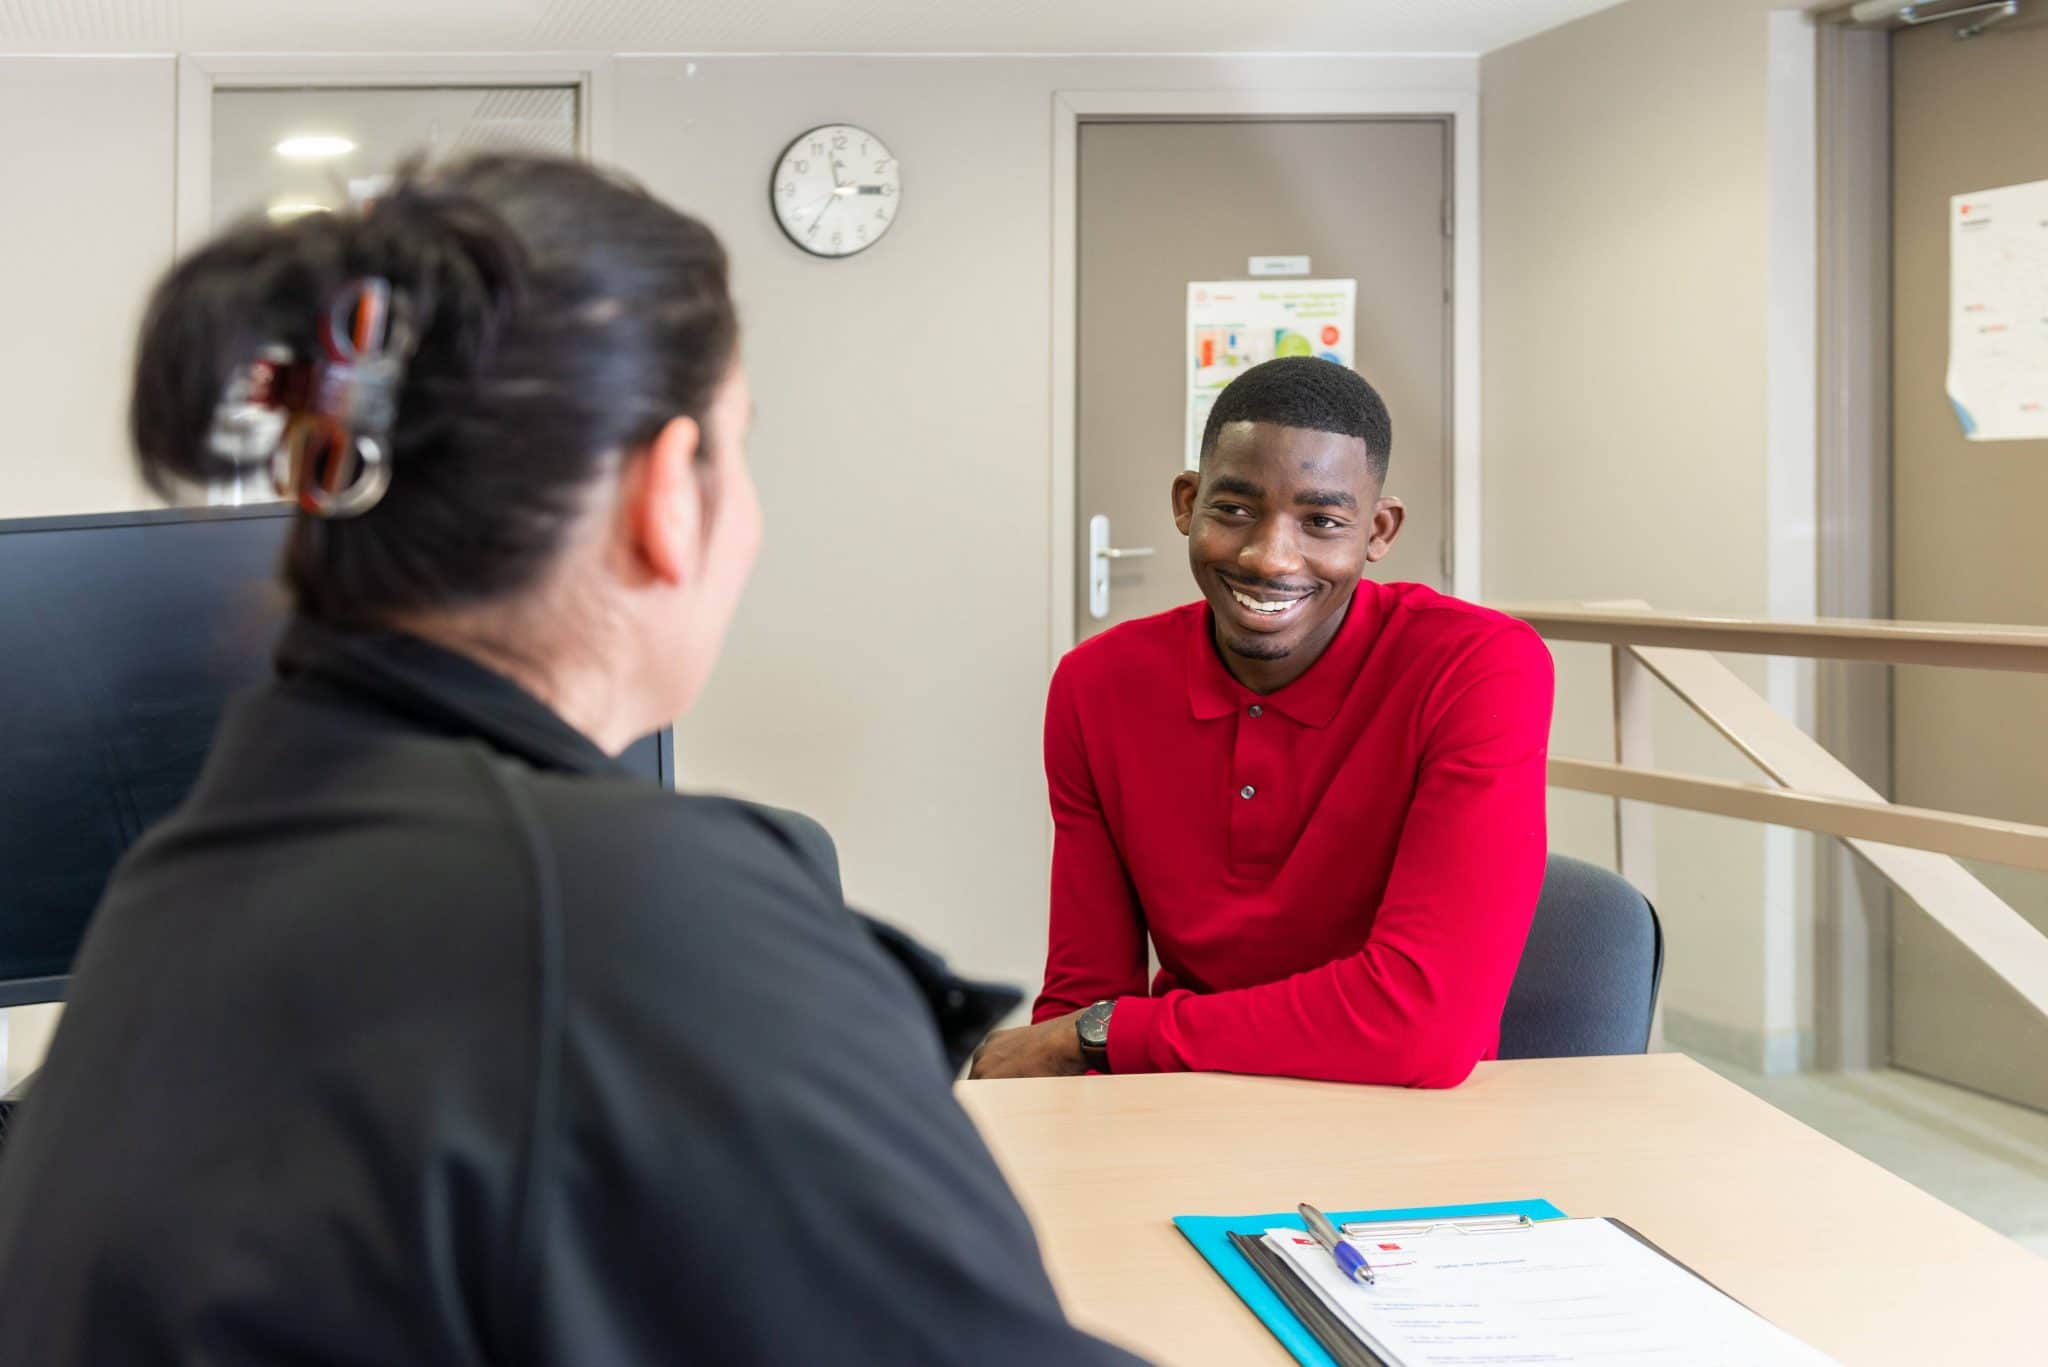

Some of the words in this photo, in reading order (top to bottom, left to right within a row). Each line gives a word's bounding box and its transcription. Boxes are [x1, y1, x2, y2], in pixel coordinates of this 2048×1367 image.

[811, 143, 823, 156] 11
[831, 136, 848, 150] 12
[860, 143, 867, 156] 1
[794, 160, 808, 174] 10
[874, 160, 886, 174] 2
[784, 182, 795, 197] 9
[881, 183, 893, 197] 3
[874, 208, 888, 221] 4
[831, 232, 842, 246] 6
